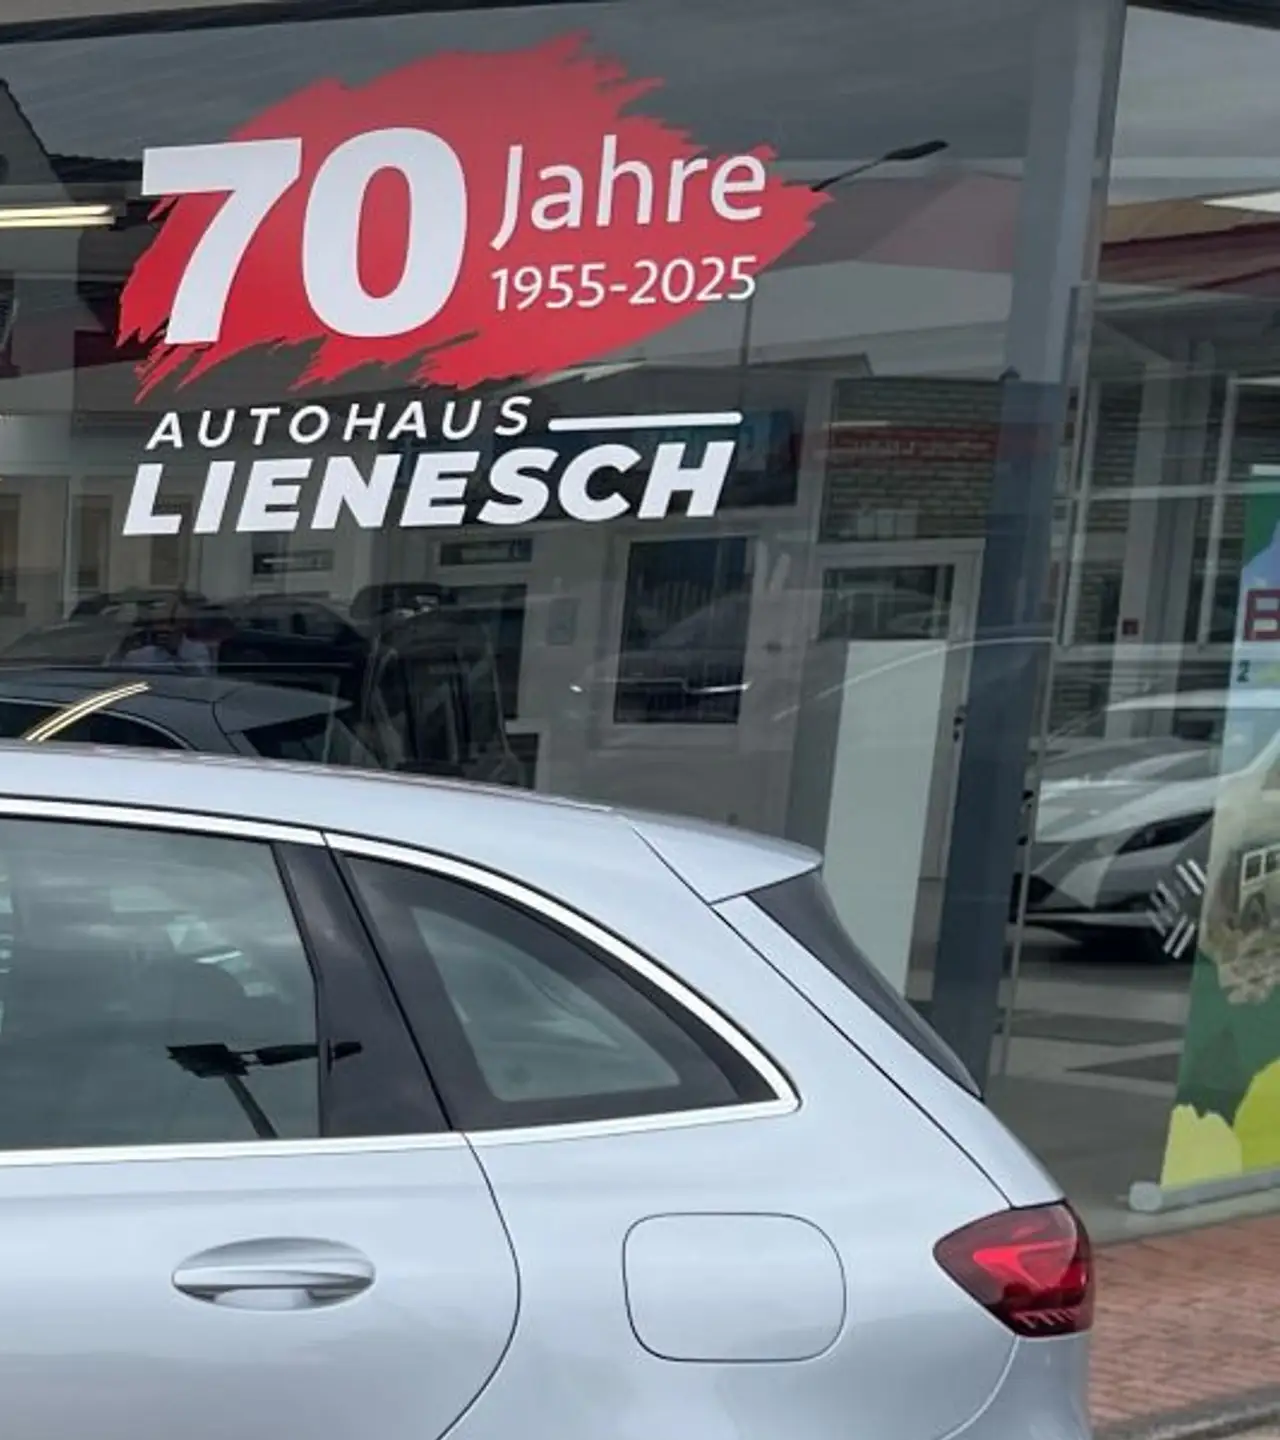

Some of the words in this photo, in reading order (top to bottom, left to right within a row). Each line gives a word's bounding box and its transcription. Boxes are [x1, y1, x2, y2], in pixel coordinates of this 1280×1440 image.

[142, 127, 467, 345] 70
[490, 134, 766, 251] Jahre
[490, 255, 758, 312] 1955-2025
[146, 396, 533, 450] AUTOHAUS
[123, 441, 735, 536] LIENESCH
